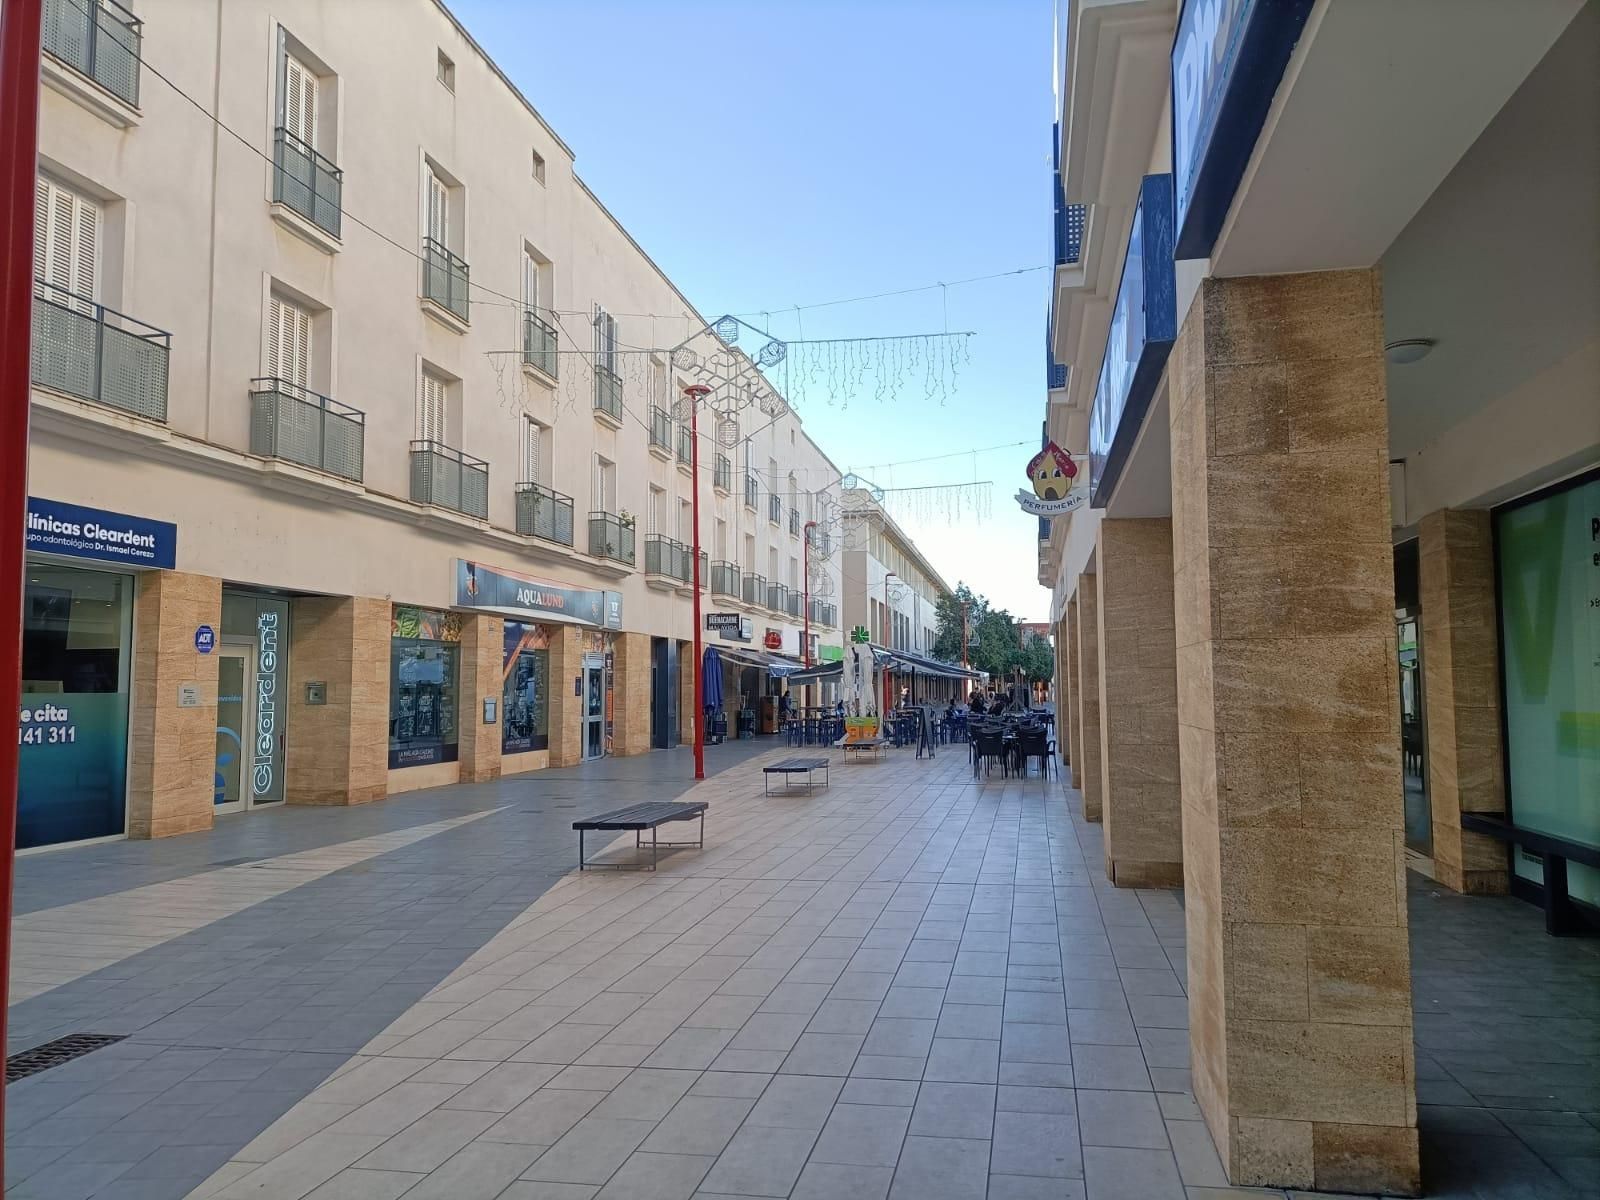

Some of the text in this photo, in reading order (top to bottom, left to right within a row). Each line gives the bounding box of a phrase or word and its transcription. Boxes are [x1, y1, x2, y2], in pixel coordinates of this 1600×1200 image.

[27, 512, 155, 548] línicas Cleardent
[26, 533, 155, 558] upo odontológico Dr. Ismael Cerezo
[198, 633, 212, 643] ADT
[20, 703, 68, 723] e cita
[253, 612, 278, 794] Cleardent
[48, 726, 76, 743] 311
